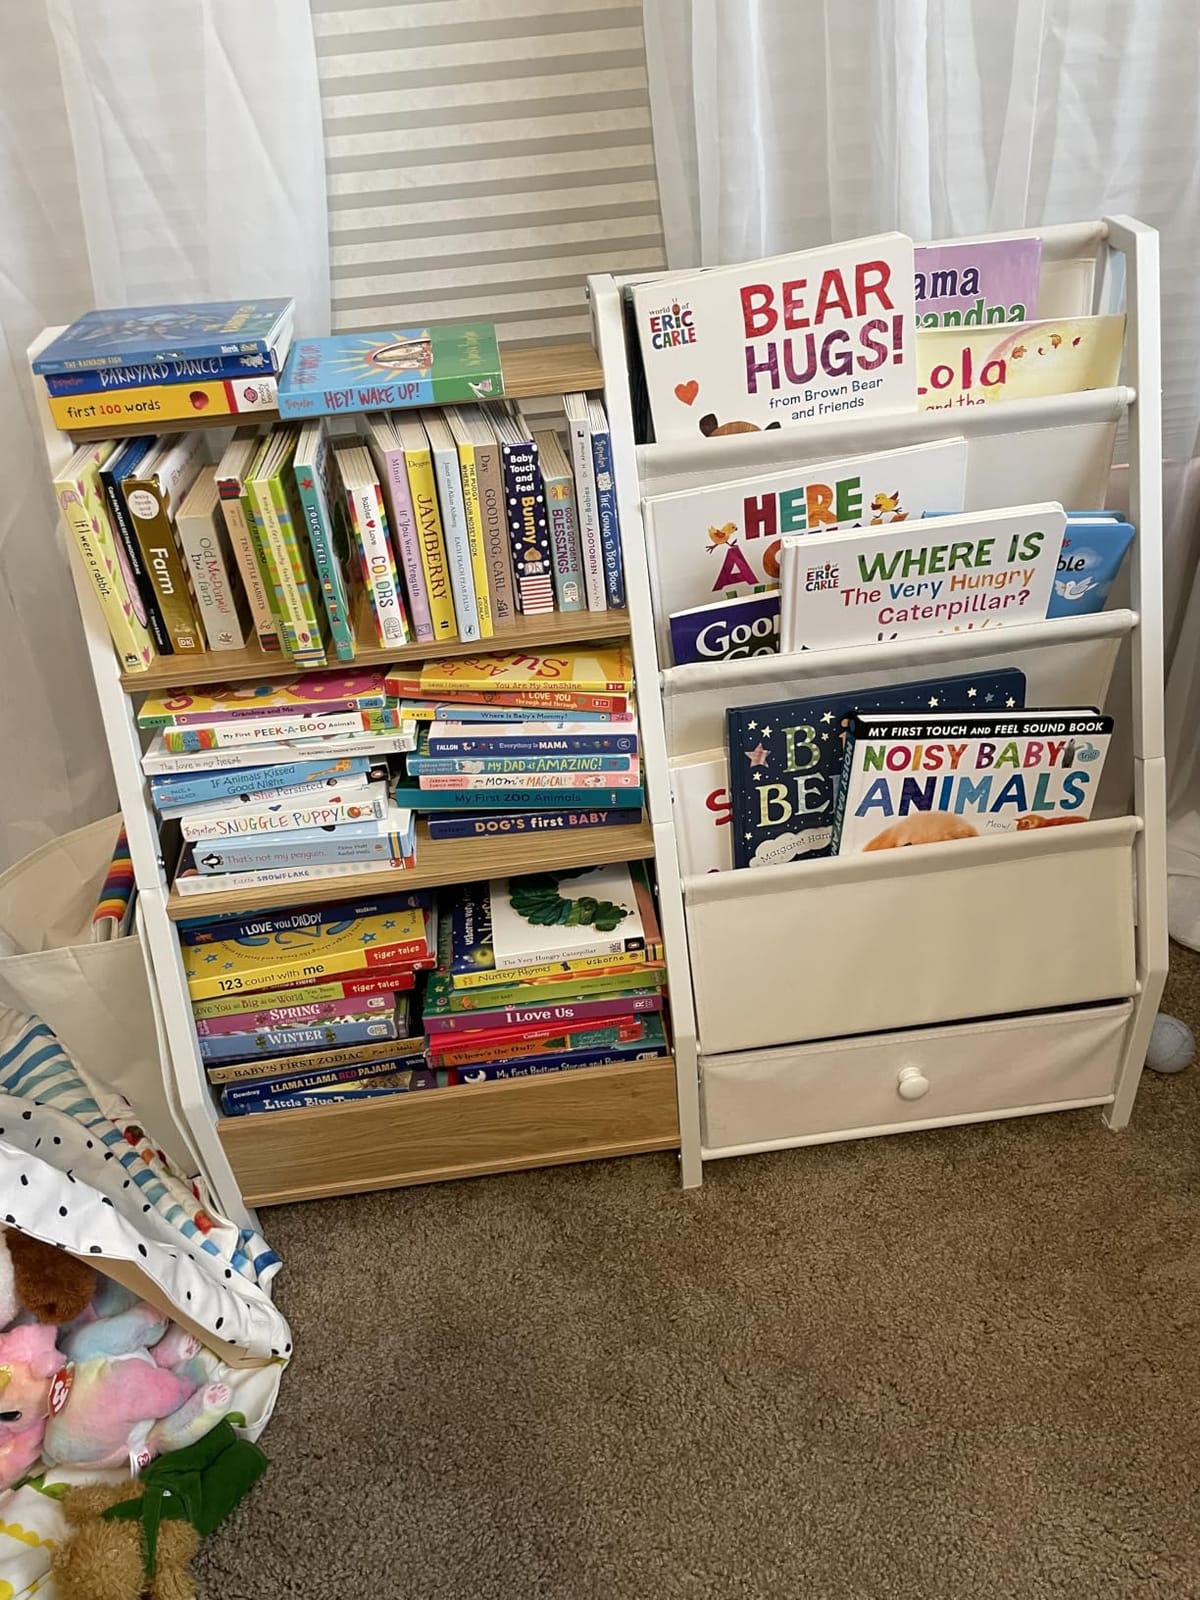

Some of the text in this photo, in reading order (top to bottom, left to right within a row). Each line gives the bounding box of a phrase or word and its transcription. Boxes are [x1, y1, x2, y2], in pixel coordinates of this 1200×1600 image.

[740, 259, 895, 339] BEAR
[649, 310, 693, 334] ERIC
[652, 327, 696, 350] CARLE
[745, 314, 904, 394] HUGS!
[99, 357, 225, 387] BARNYARD DANCE!
[324, 381, 421, 409] HEY! WAKE UP!
[769, 377, 884, 410] from Brown Bear
[66, 399, 161, 419] first 100 words
[791, 396, 865, 420] and Friends
[509, 453, 534, 465] Baby
[509, 462, 536, 474] Touch
[515, 472, 533, 483] and
[515, 482, 536, 493] Feel
[600, 492, 611, 508] THE
[744, 477, 862, 540] HERE
[306, 503, 323, 536] TOUCH
[398, 518, 413, 538] You
[478, 454, 506, 593] Day GOOD DOG, CARL
[519, 495, 539, 546] Bunny
[79, 534, 95, 559] were
[199, 535, 215, 561] Old
[239, 536, 251, 554] TEN
[403, 538, 414, 557] Were
[416, 492, 448, 602] JAMBERRY
[469, 538, 479, 558] BOOK
[551, 509, 569, 574] BLESSINGS
[586, 527, 598, 575] NEUROLOGY
[244, 553, 258, 580] LITTLE
[605, 551, 617, 569] BED
[857, 531, 1046, 584] WHERE IS
[149, 544, 179, 597] Farm
[370, 555, 394, 609] COLORS
[406, 563, 422, 598] Penguin
[607, 570, 620, 594] BOOK
[806, 567, 840, 582] ERIC
[199, 578, 216, 608] farm
[252, 580, 267, 611] RABBITS
[805, 579, 840, 592] CARLE
[840, 567, 1037, 608] The Very Hungry
[877, 588, 1032, 626] Caterpillar?
[529, 692, 572, 701] LOVE YOU
[253, 721, 327, 739] PEEK-A-BOO
[868, 720, 1105, 738] MY FIRST TOUCH AND FEEL SOUND BOOK
[436, 742, 459, 751] FALLON
[539, 740, 568, 750] MAMA
[863, 740, 1065, 773] NOISY BABY
[503, 756, 602, 772] DAD AMAZING!
[210, 766, 295, 789] If Animals Kissed
[227, 777, 284, 794] Good Night
[252, 780, 324, 800] She Persisted
[455, 792, 582, 805] My First ZOO Animals
[854, 770, 1091, 818] ANIMALS
[216, 804, 346, 836] SNUGGLE PUPPY!
[475, 820, 526, 833] DOG'S
[530, 817, 564, 829] first
[569, 812, 609, 826] BABY
[253, 851, 268, 862] not
[269, 850, 287, 863] my
[257, 869, 310, 883] SNOWFLAKE
[246, 921, 273, 936] LOVE
[373, 944, 421, 961] tiger tales
[218, 963, 326, 992] 123 count with me
[352, 978, 400, 994] tiger tales
[242, 997, 260, 1011] Big
[269, 1003, 321, 1020] SPRING
[506, 1007, 574, 1023] I Us
[267, 1029, 323, 1046] WINTER
[233, 1063, 278, 1078] BABY'S
[279, 1058, 315, 1072] FIRST
[317, 1050, 365, 1066] ZODIAC
[496, 1068, 511, 1080] My
[270, 1079, 304, 1094] LLAMA
[303, 1072, 338, 1087] LLAMA
[358, 1061, 397, 1077] PAJAMA
